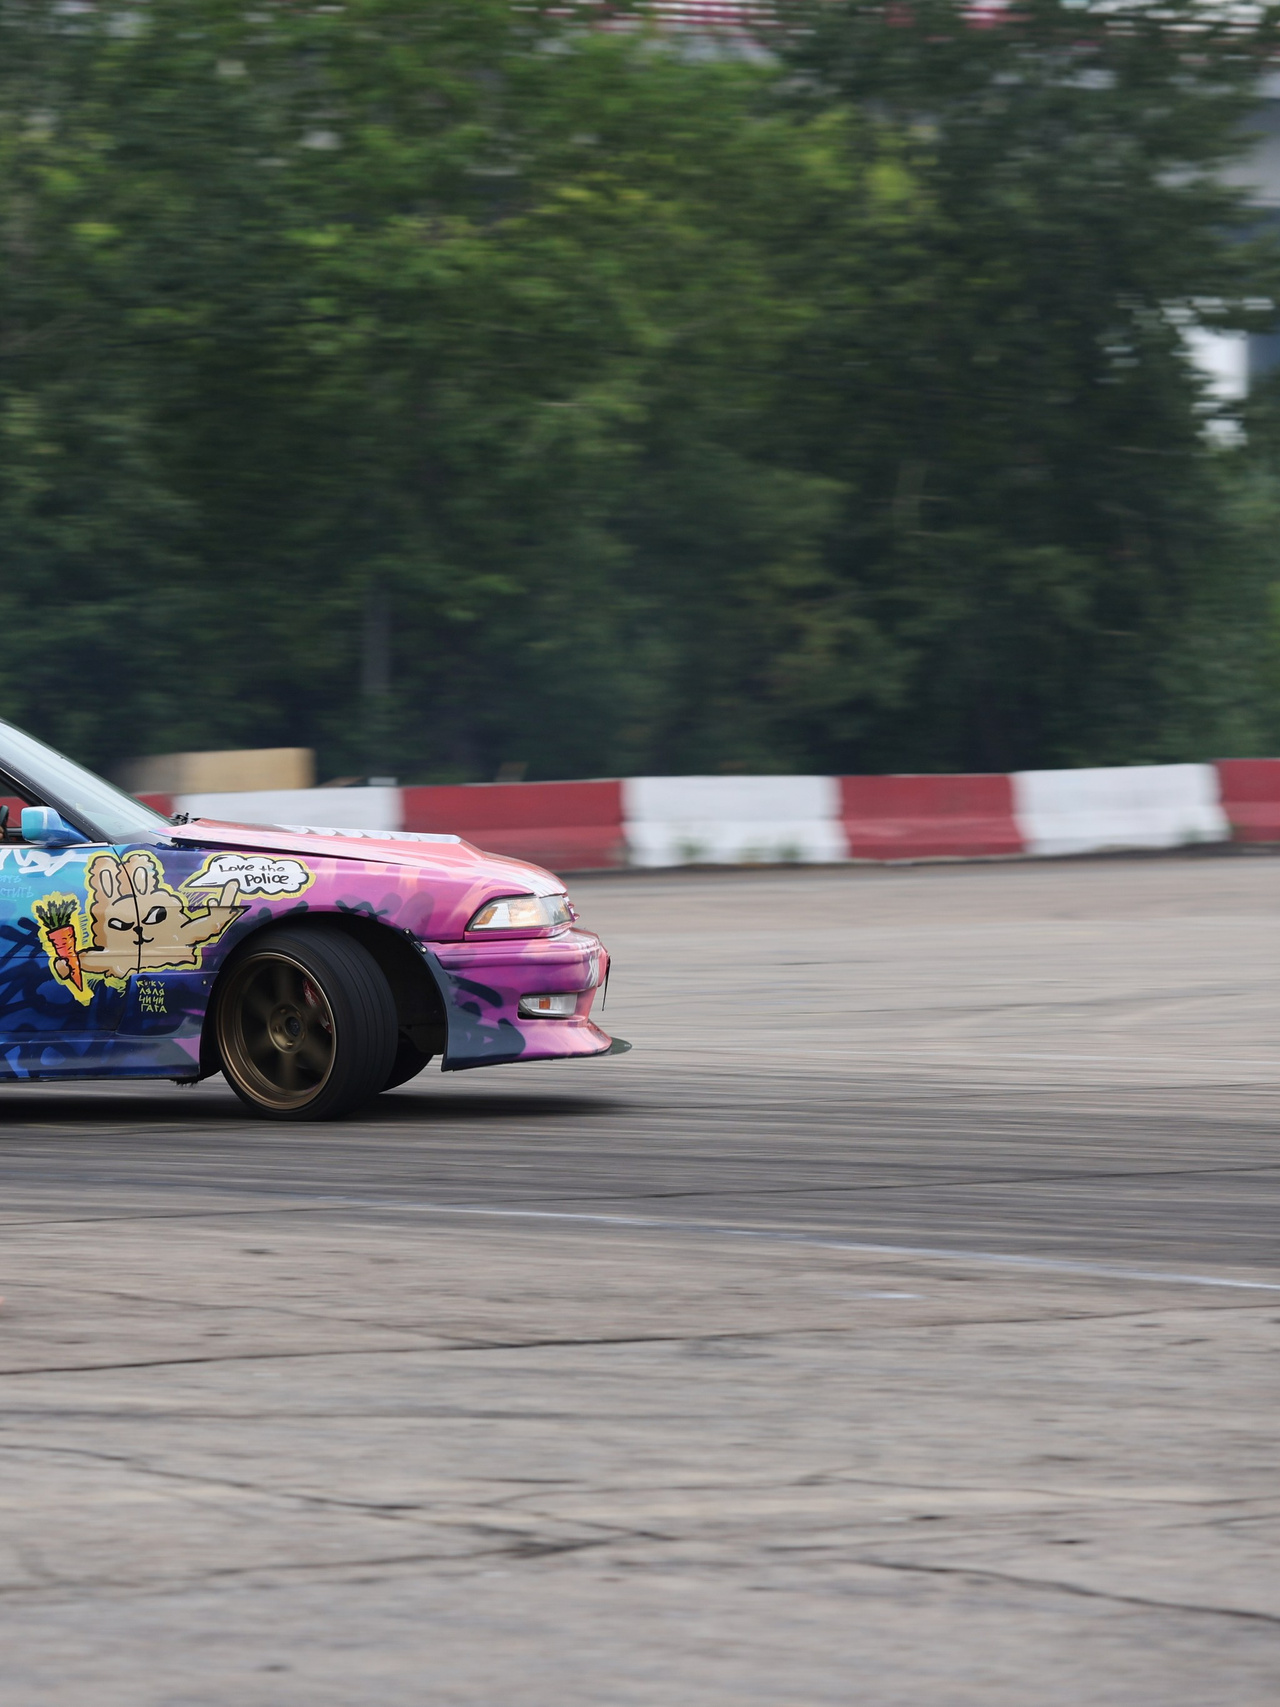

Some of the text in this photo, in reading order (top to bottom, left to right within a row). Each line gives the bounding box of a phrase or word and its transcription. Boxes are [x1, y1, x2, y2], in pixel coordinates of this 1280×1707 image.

[219, 864, 255, 872] Love
[139, 995, 164, 1004] ЧИЧИ
[141, 1003, 167, 1013] ГАГА
